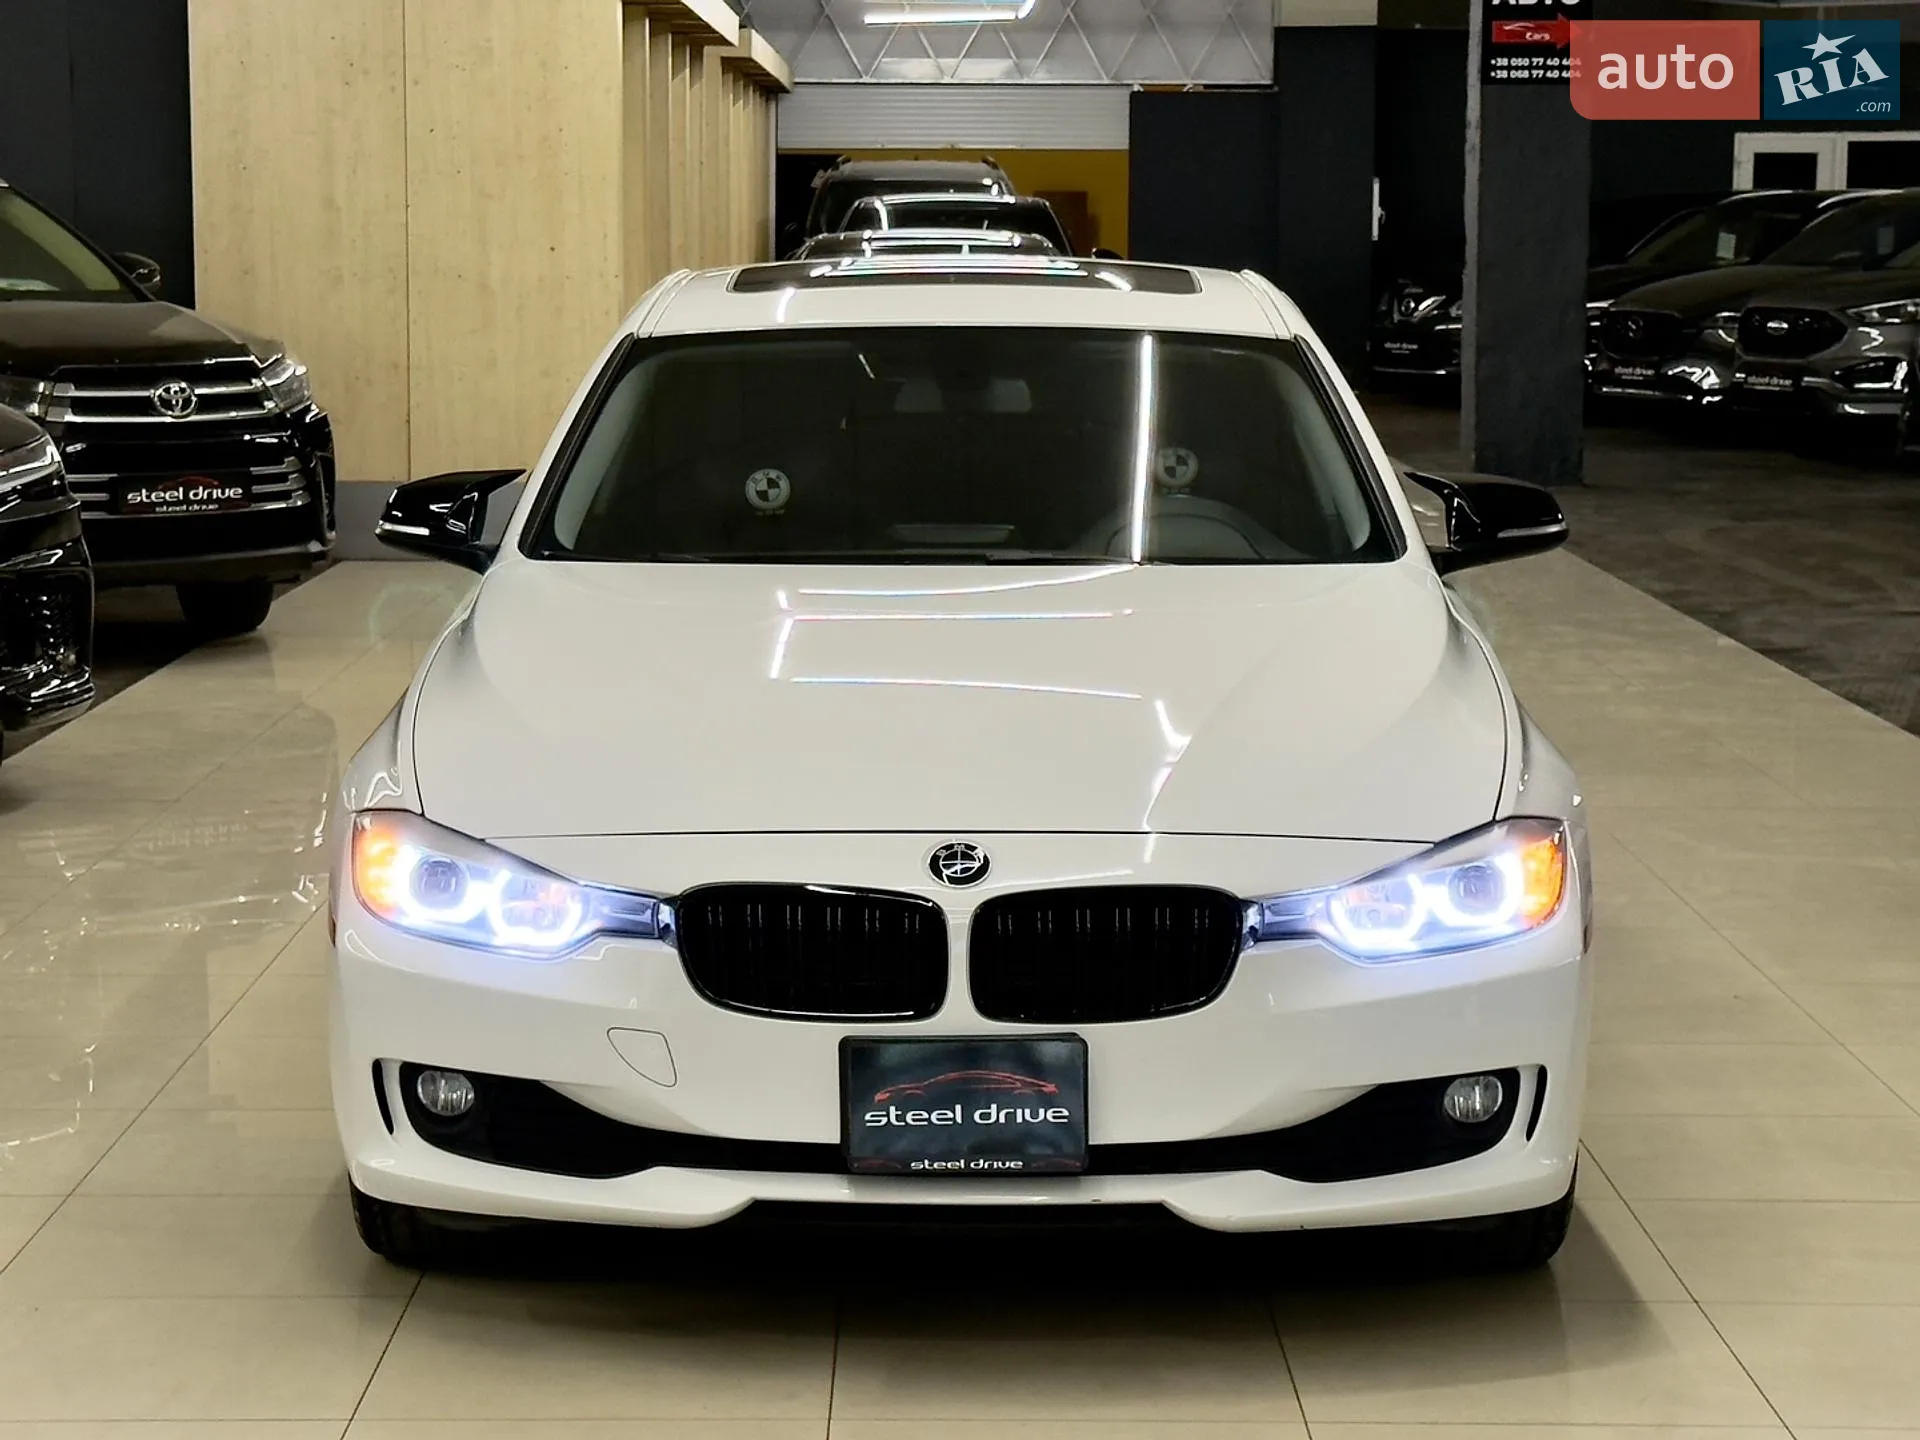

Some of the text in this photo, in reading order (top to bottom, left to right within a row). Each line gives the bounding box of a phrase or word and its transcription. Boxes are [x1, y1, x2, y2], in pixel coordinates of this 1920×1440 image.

[1525, 32, 1551, 41] Cars
[1531, 57, 1545, 67] 77
[1546, 57, 1560, 67] 40
[1531, 69, 1545, 79] 77
[1545, 69, 1560, 79] 40
[127, 485, 243, 504] steel drive
[155, 503, 219, 513] steel drive
[864, 1103, 1070, 1127] steel drive
[910, 1158, 1024, 1170] steel drive
